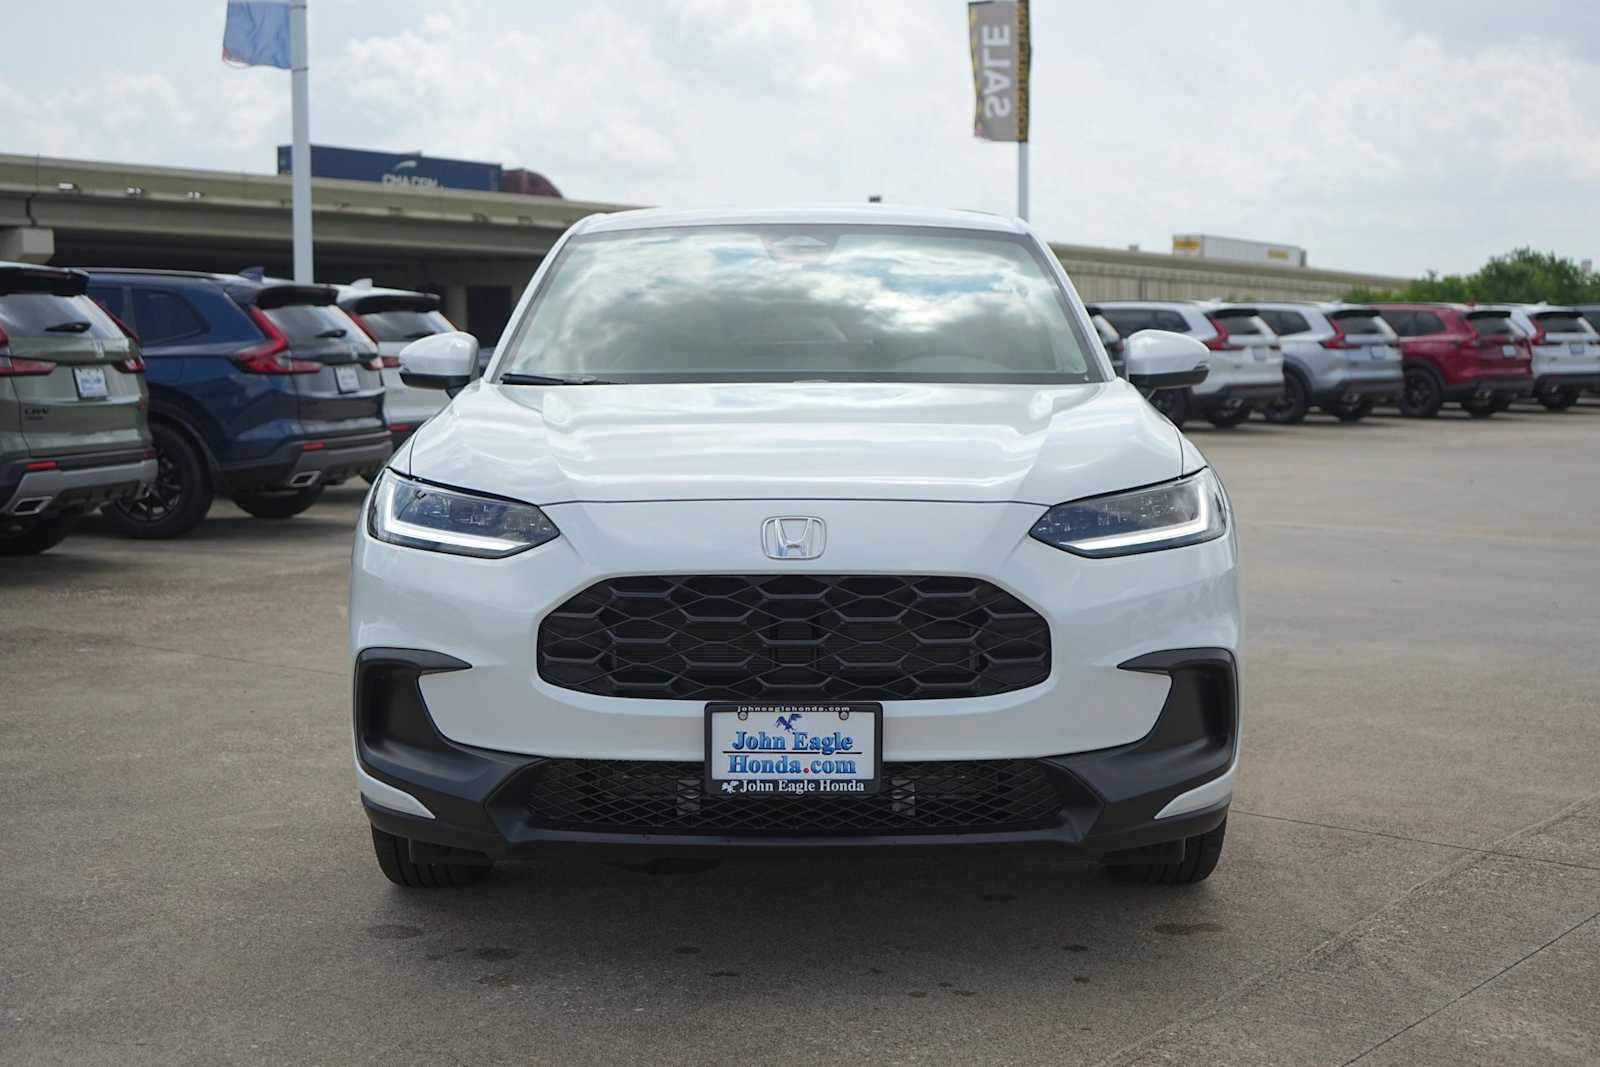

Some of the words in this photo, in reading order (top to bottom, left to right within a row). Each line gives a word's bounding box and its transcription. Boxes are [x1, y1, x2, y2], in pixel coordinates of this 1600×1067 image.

[732, 731, 786, 751] John
[792, 731, 854, 755] Eagle
[727, 754, 857, 774] Honda.com
[740, 780, 774, 793] John
[778, 780, 816, 795] Eagle
[819, 780, 865, 793] Honda
